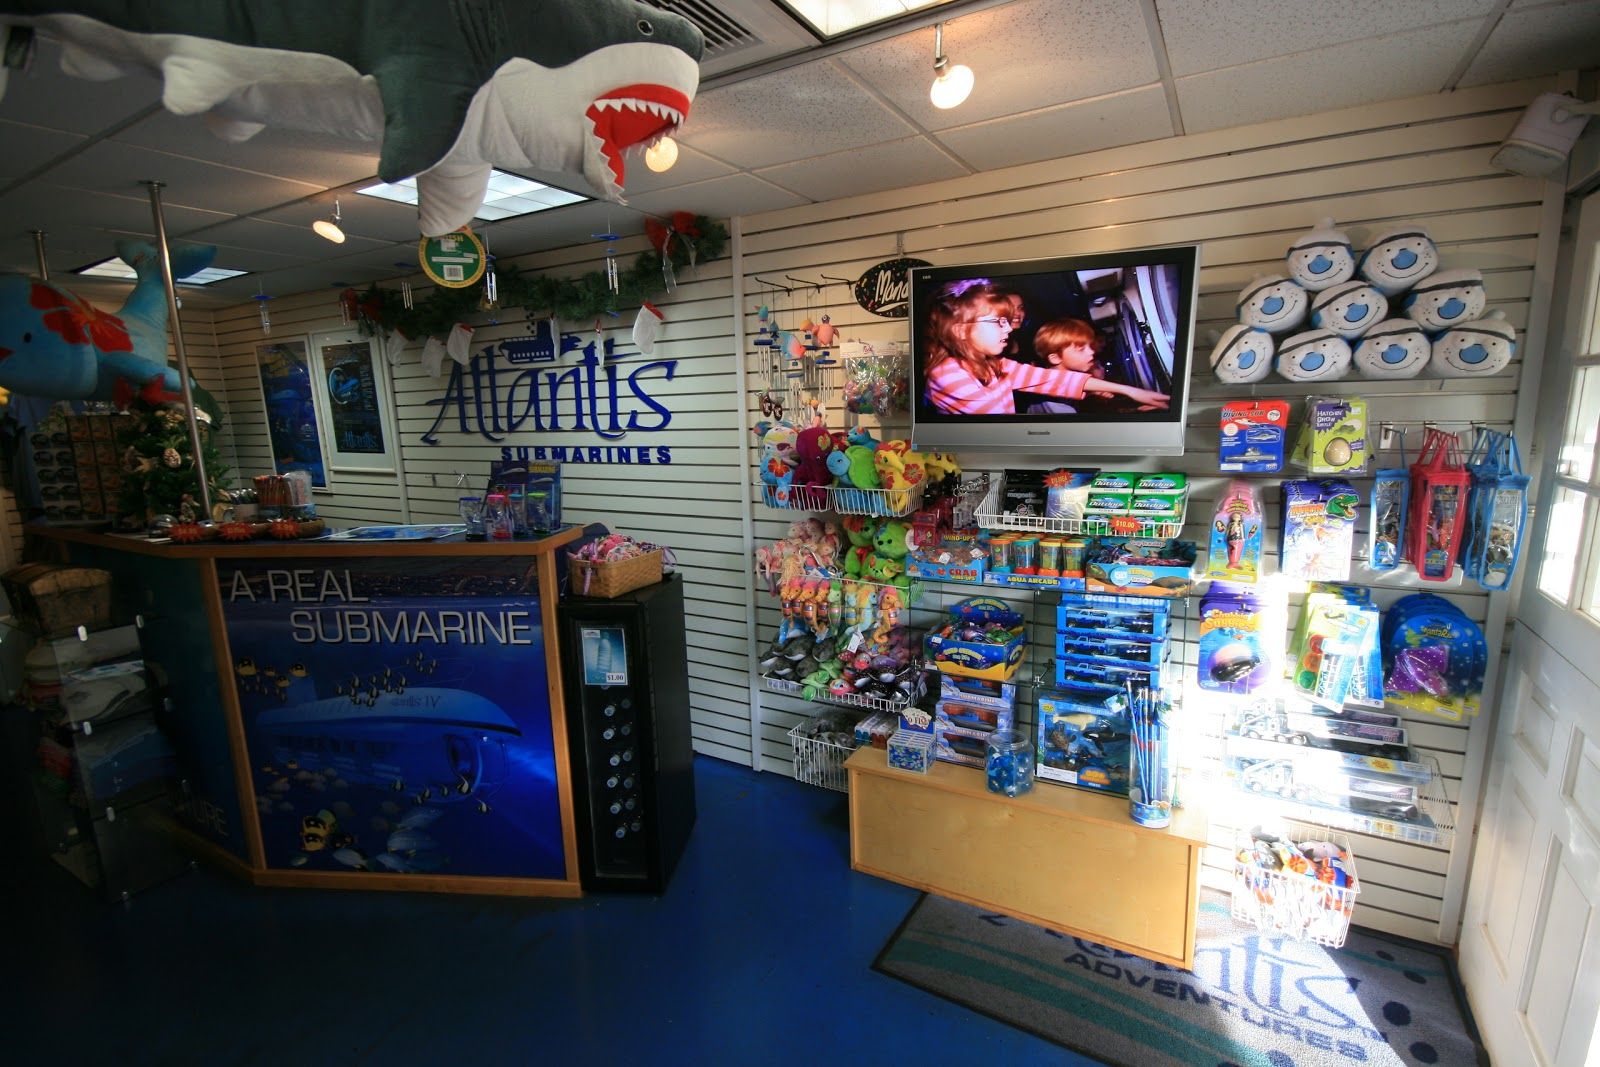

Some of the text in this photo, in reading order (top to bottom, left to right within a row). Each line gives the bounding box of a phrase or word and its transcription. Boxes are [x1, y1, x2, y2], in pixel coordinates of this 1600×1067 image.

[420, 338, 678, 444] Atlantis
[501, 446, 672, 465] SUBMARINES
[1116, 521, 1135, 529] $10.00
[230, 569, 370, 602] A REAL
[949, 568, 978, 577] CRAB
[1028, 577, 1058, 585] ARCADE
[289, 610, 532, 645] SUBMARINE
[1064, 952, 1369, 1061] ADVENTURES
